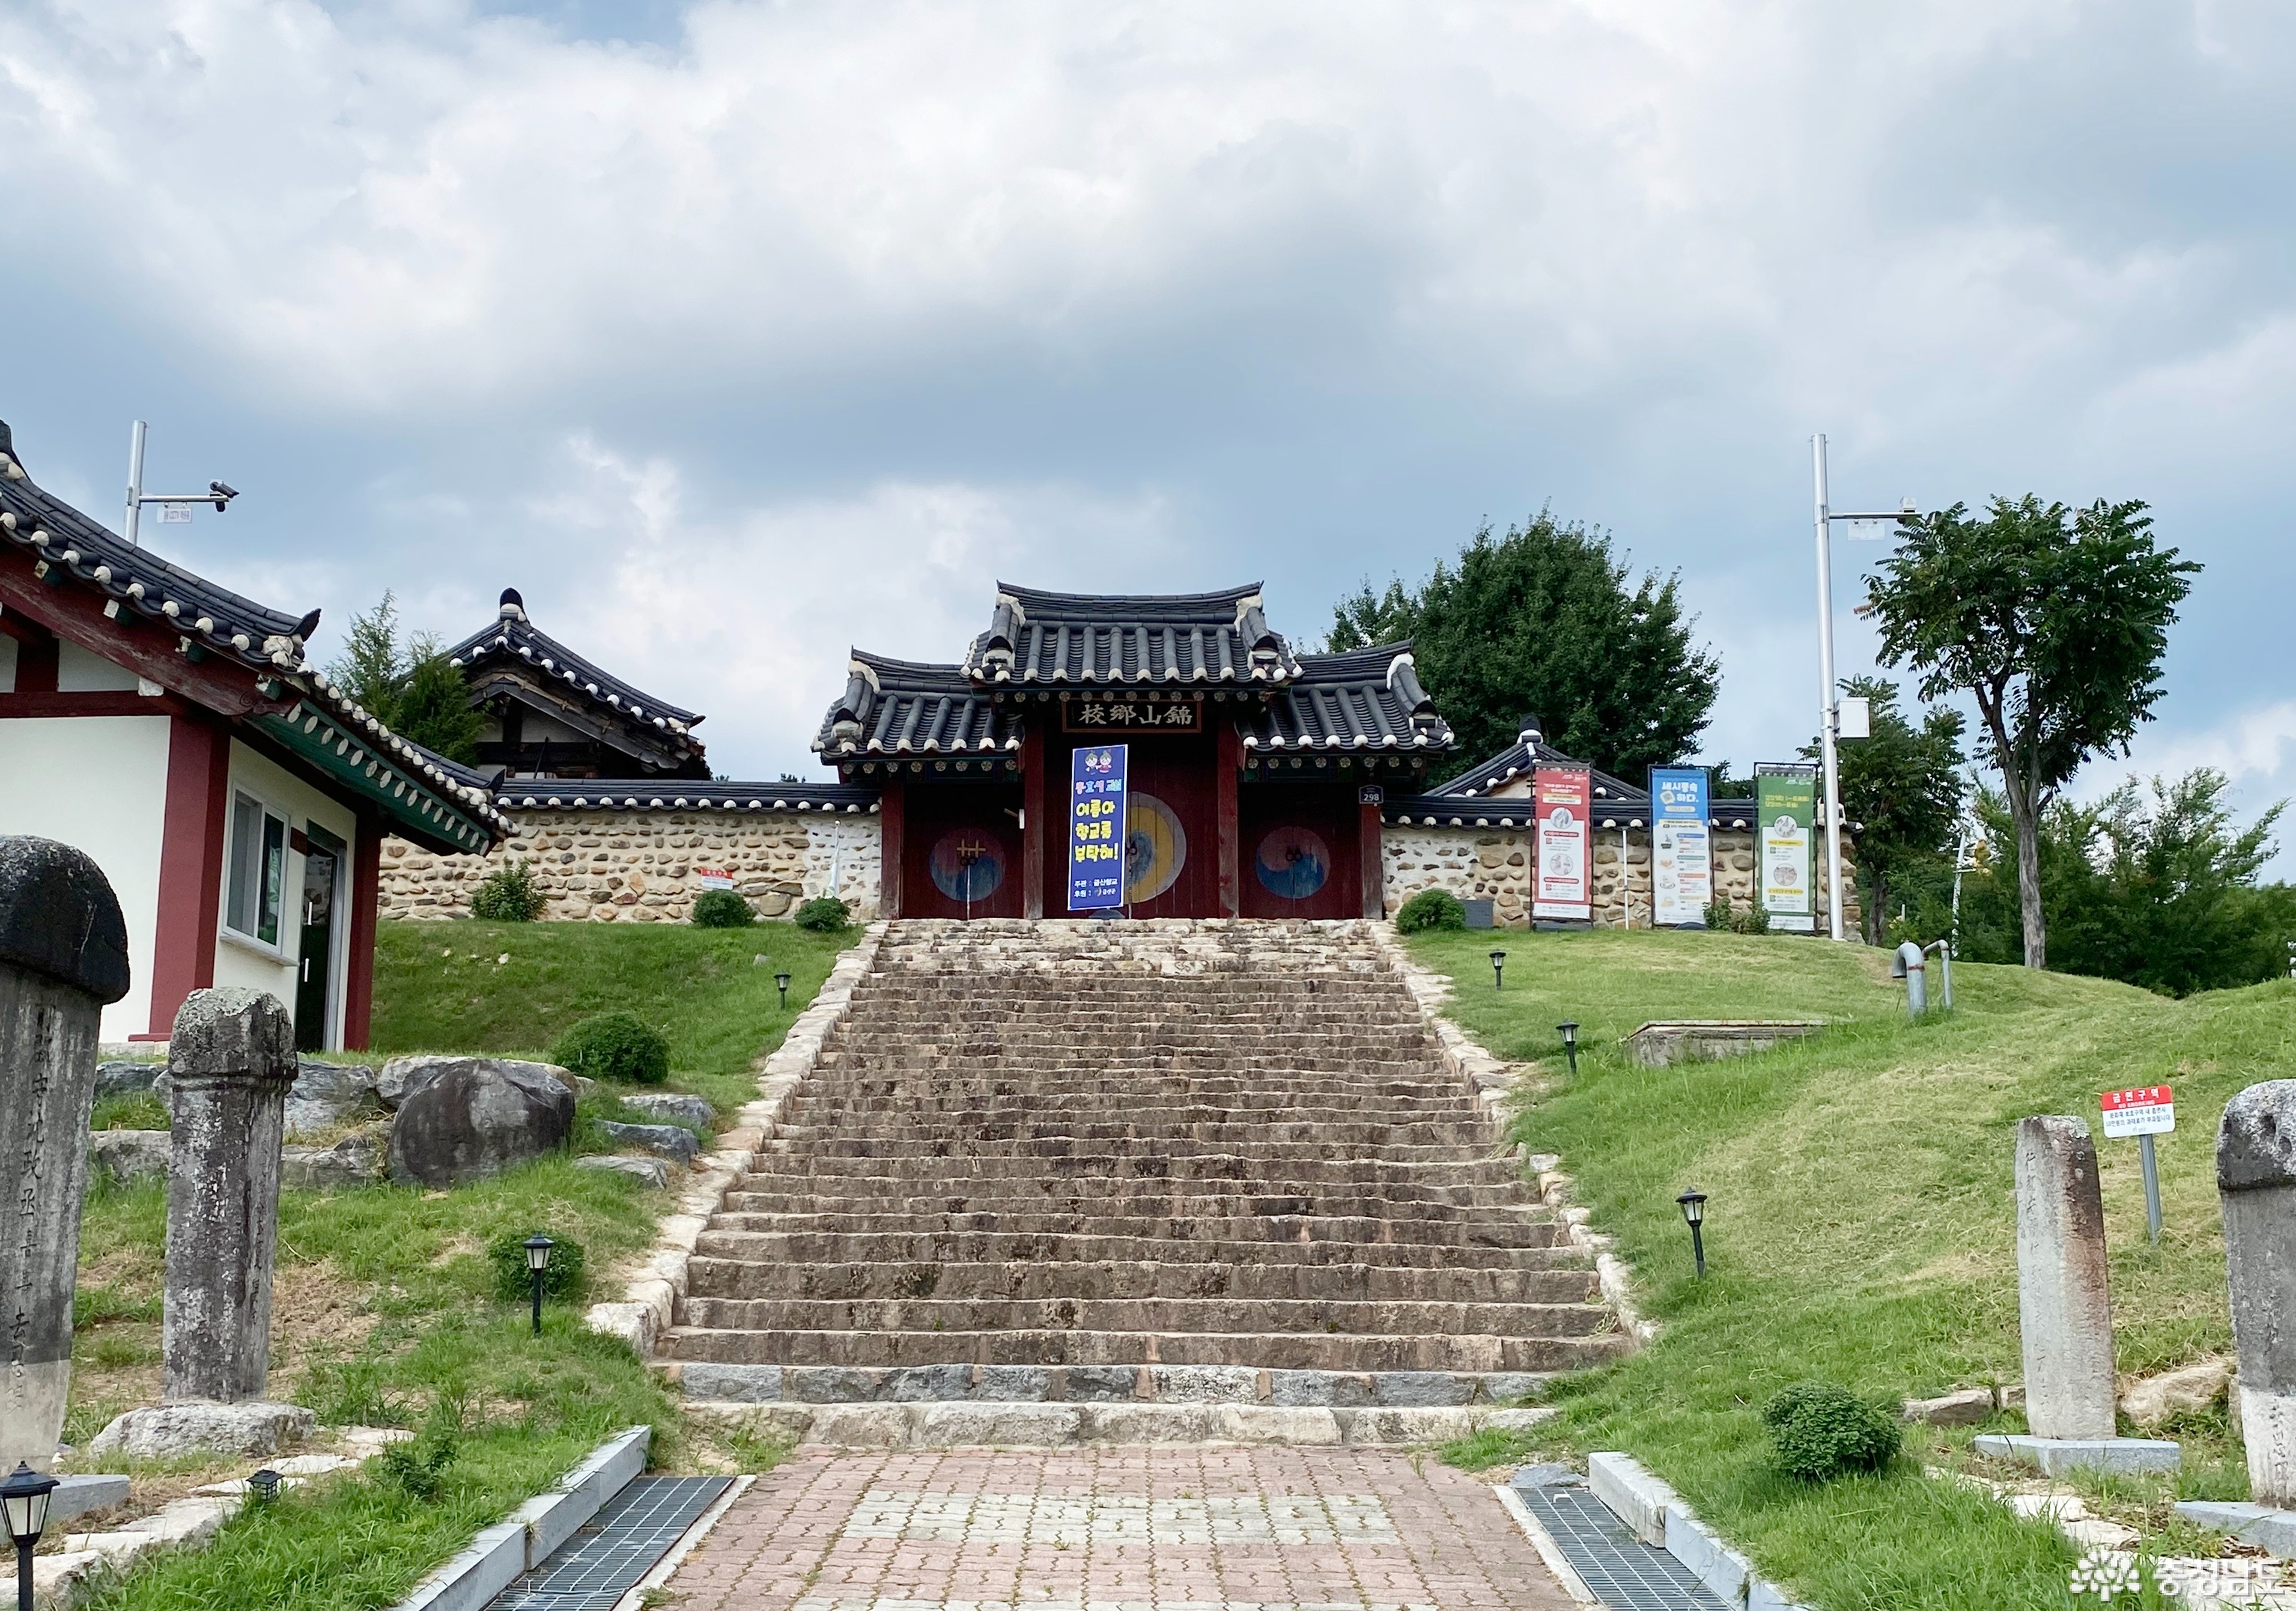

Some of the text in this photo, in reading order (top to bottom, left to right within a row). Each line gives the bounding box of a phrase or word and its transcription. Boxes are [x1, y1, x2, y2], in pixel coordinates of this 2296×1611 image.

[1662, 782, 1698, 793] 세시풍속
[1075, 820, 1112, 841] 향교를
[1075, 842, 1119, 863] 부탁해!
